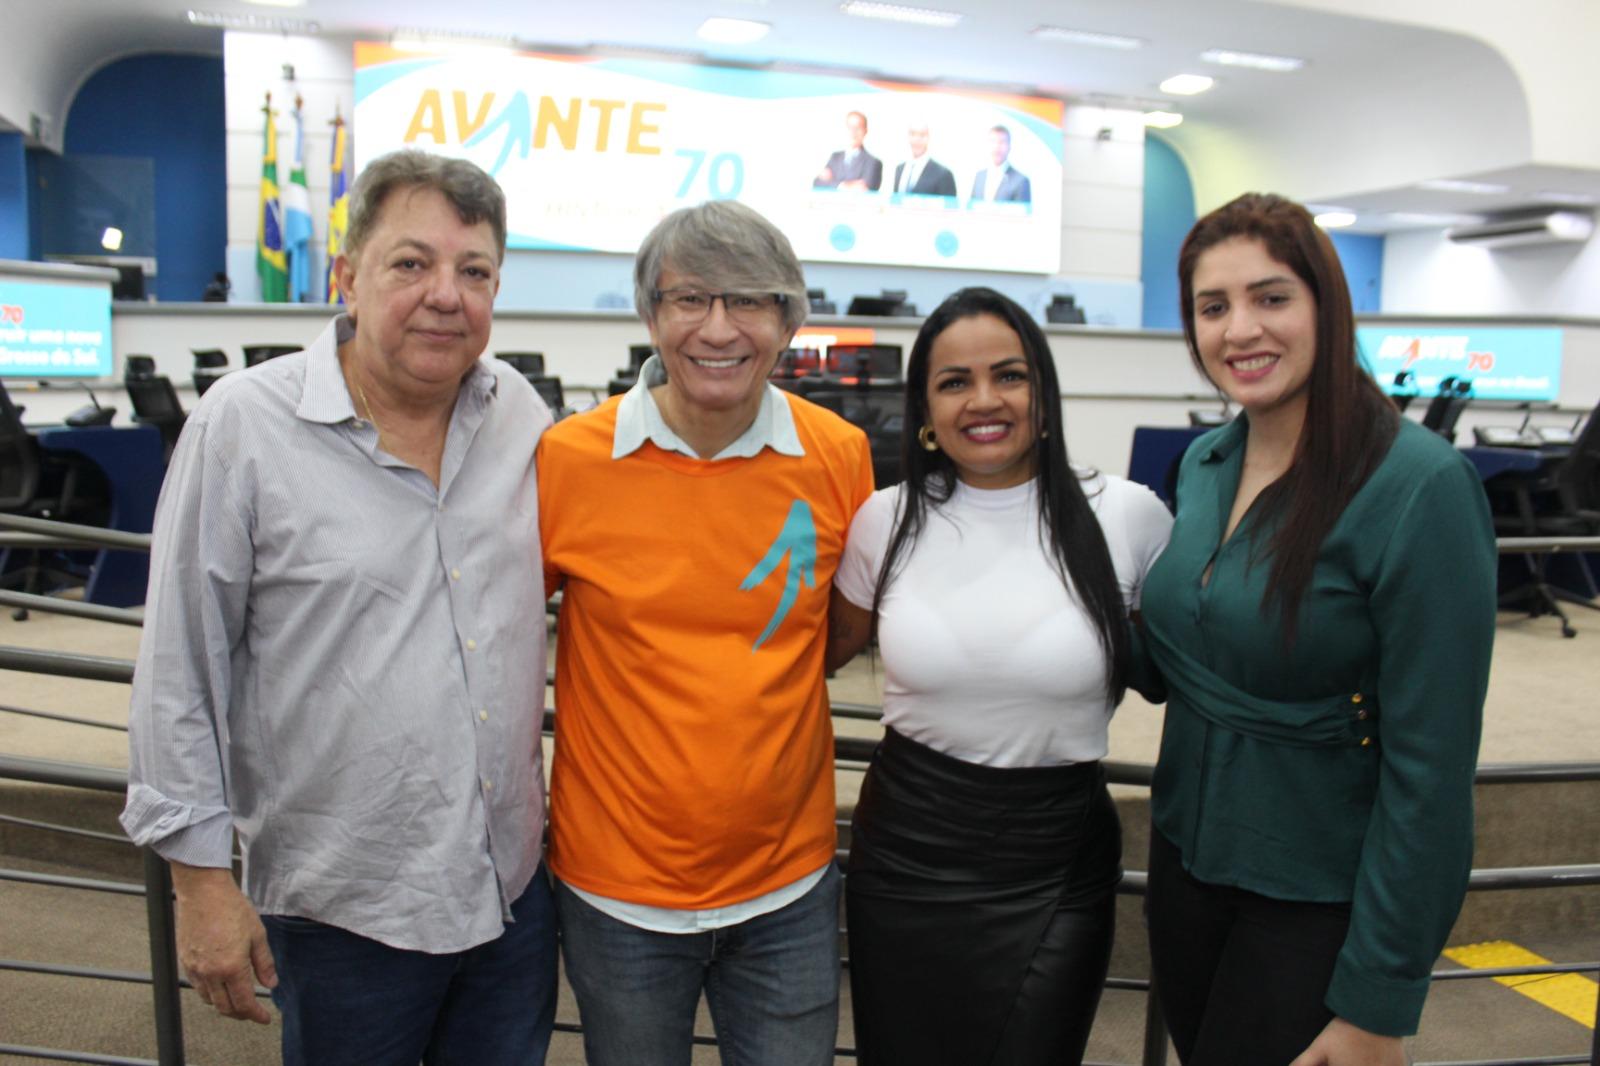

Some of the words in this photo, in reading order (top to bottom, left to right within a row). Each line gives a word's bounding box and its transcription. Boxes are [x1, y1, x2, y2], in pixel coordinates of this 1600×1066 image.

[673, 148, 745, 202] 70
[1, 304, 24, 324] 70
[1466, 351, 1495, 372] 70
